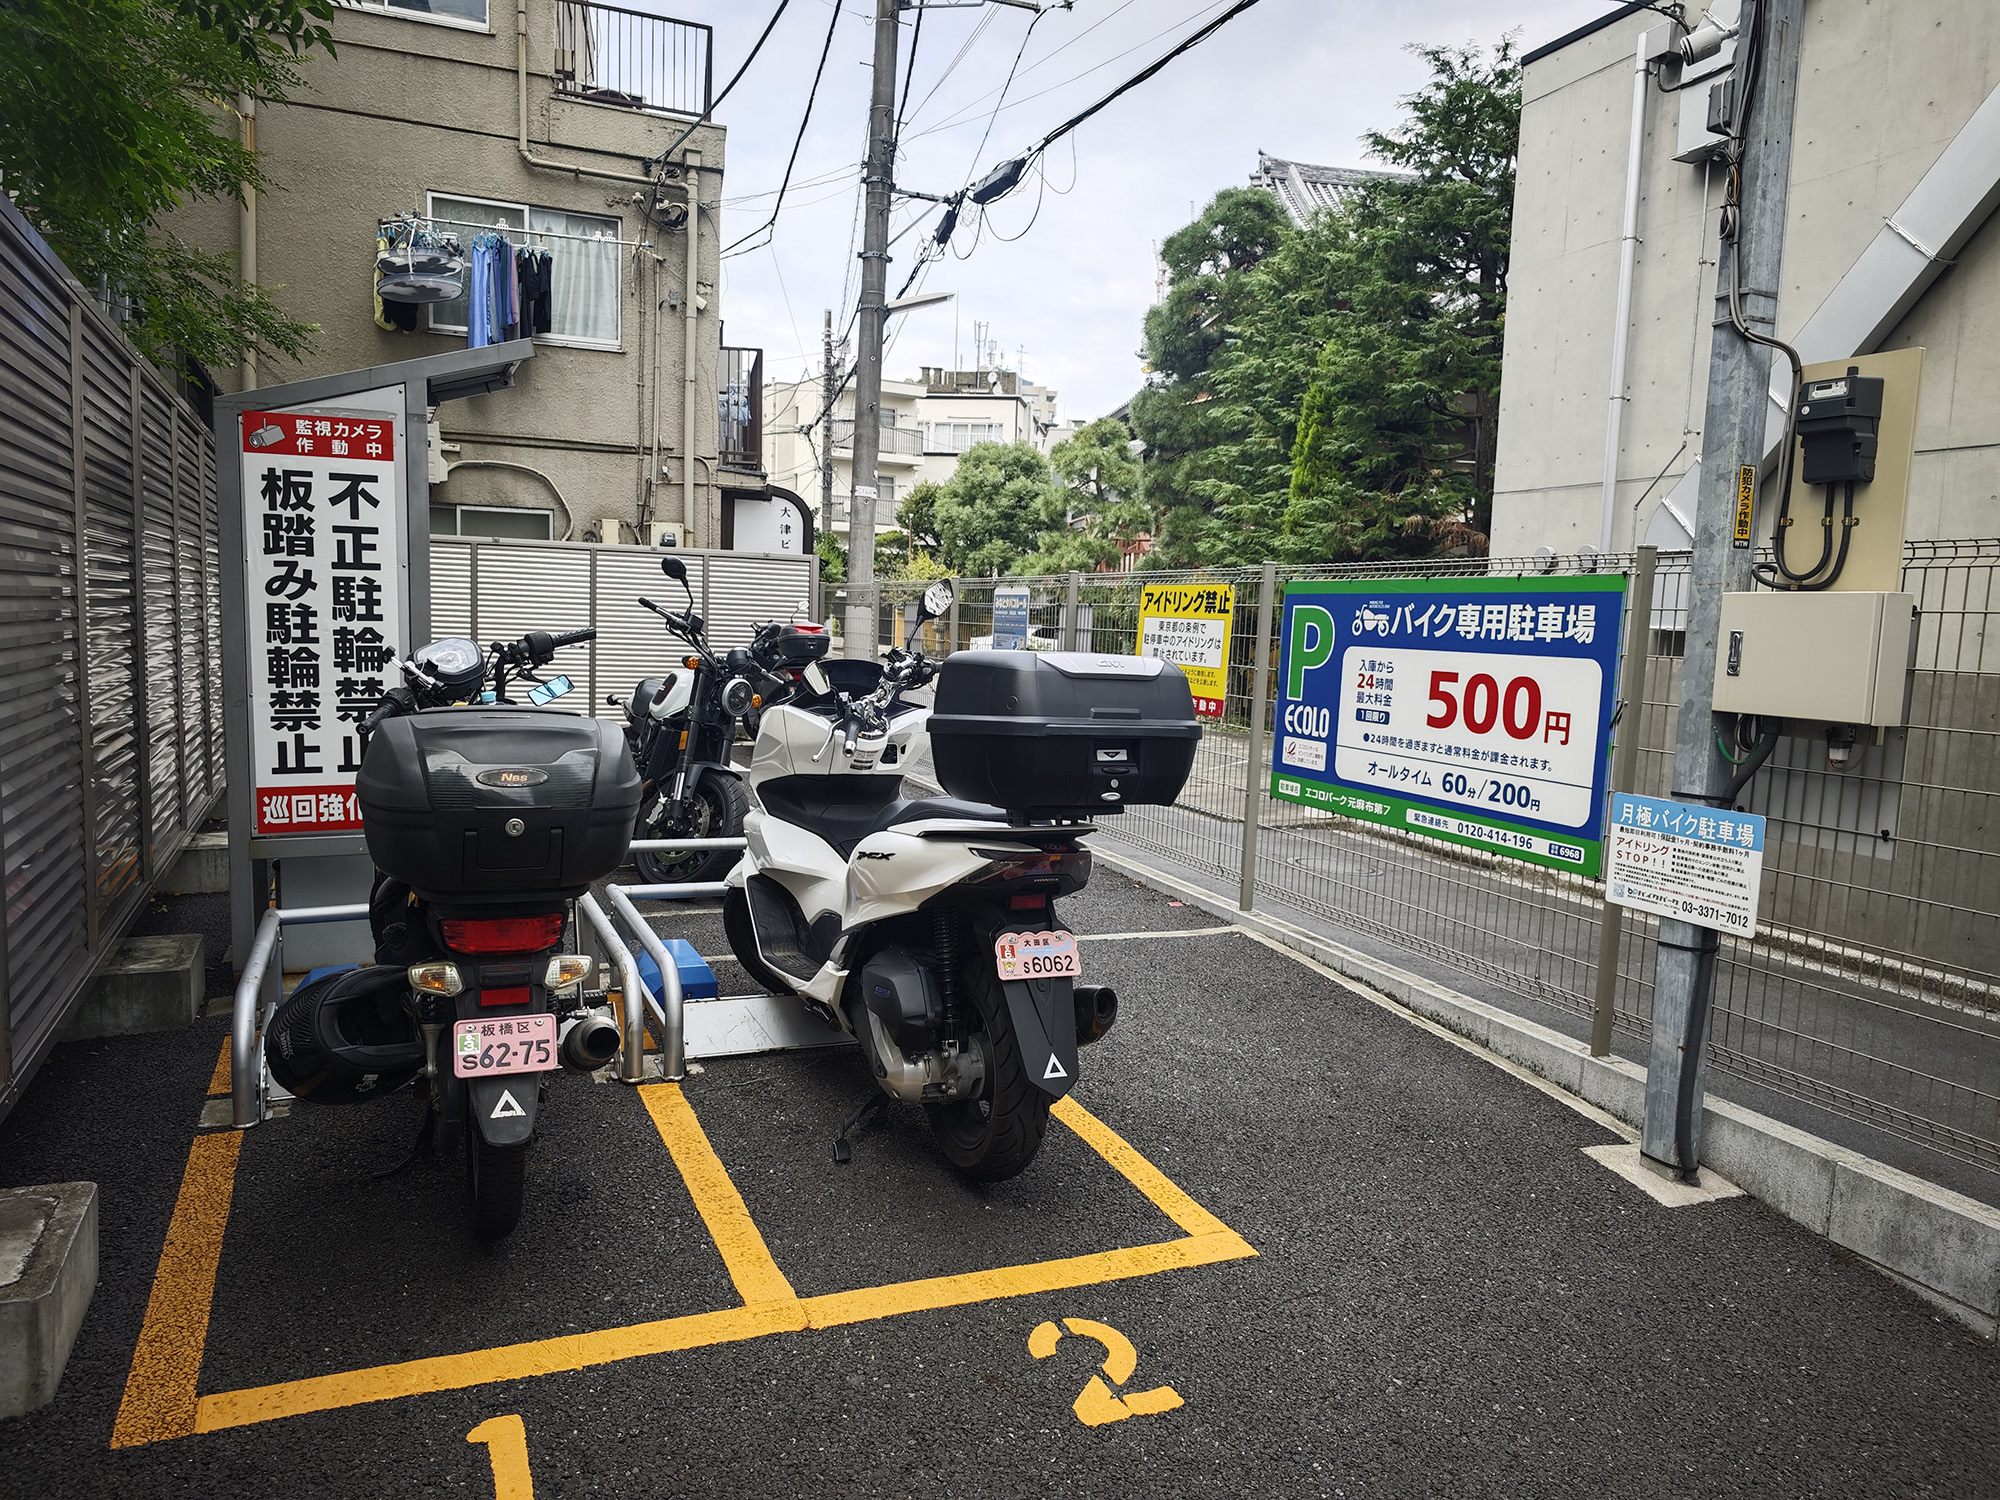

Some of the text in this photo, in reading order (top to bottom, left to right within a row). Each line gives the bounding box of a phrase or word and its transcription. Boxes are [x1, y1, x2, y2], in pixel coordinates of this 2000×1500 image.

[295, 419, 382, 440] 監視カメラ
[1737, 467, 1754, 537] 防犯カメラ作動中
[1143, 590, 1231, 614] アイドリング禁止
[261, 467, 323, 775] 板踏み駐輪禁止
[1158, 620, 1207, 635] 東京都の条例で
[1390, 602, 1596, 644] バイク専用駐車場
[1144, 633, 1222, 650] 駐停車中のアイドリングは
[1287, 605, 1336, 701] P
[1152, 647, 1208, 664] 禁止されています。
[1359, 659, 1395, 673] 入庫から
[1357, 673, 1394, 691] 24時間
[1356, 691, 1393, 707] 最大料金
[1426, 670, 1572, 746] 500円
[1284, 703, 1330, 739] ECOLO
[1367, 760, 1432, 787] オールタイム
[1305, 787, 1391, 816] エコロパーク元麻布第7
[1413, 812, 1449, 830] 緊急連絡先
[1457, 822, 1533, 850] 0120-414-196
[1620, 802, 1755, 848] 月極バイク駐車場
[1559, 847, 1580, 860] 6968
[1616, 836, 1670, 856] アイドリング
[1638, 890, 1680, 906] バイクパーク
[1681, 900, 1749, 928] 03-3371-7012
[1024, 938, 1050, 947] 大田区
[481, 1021, 531, 1037] 板橋区
[1028, 1317, 1186, 1427] 2
[466, 1414, 535, 1500] 1
